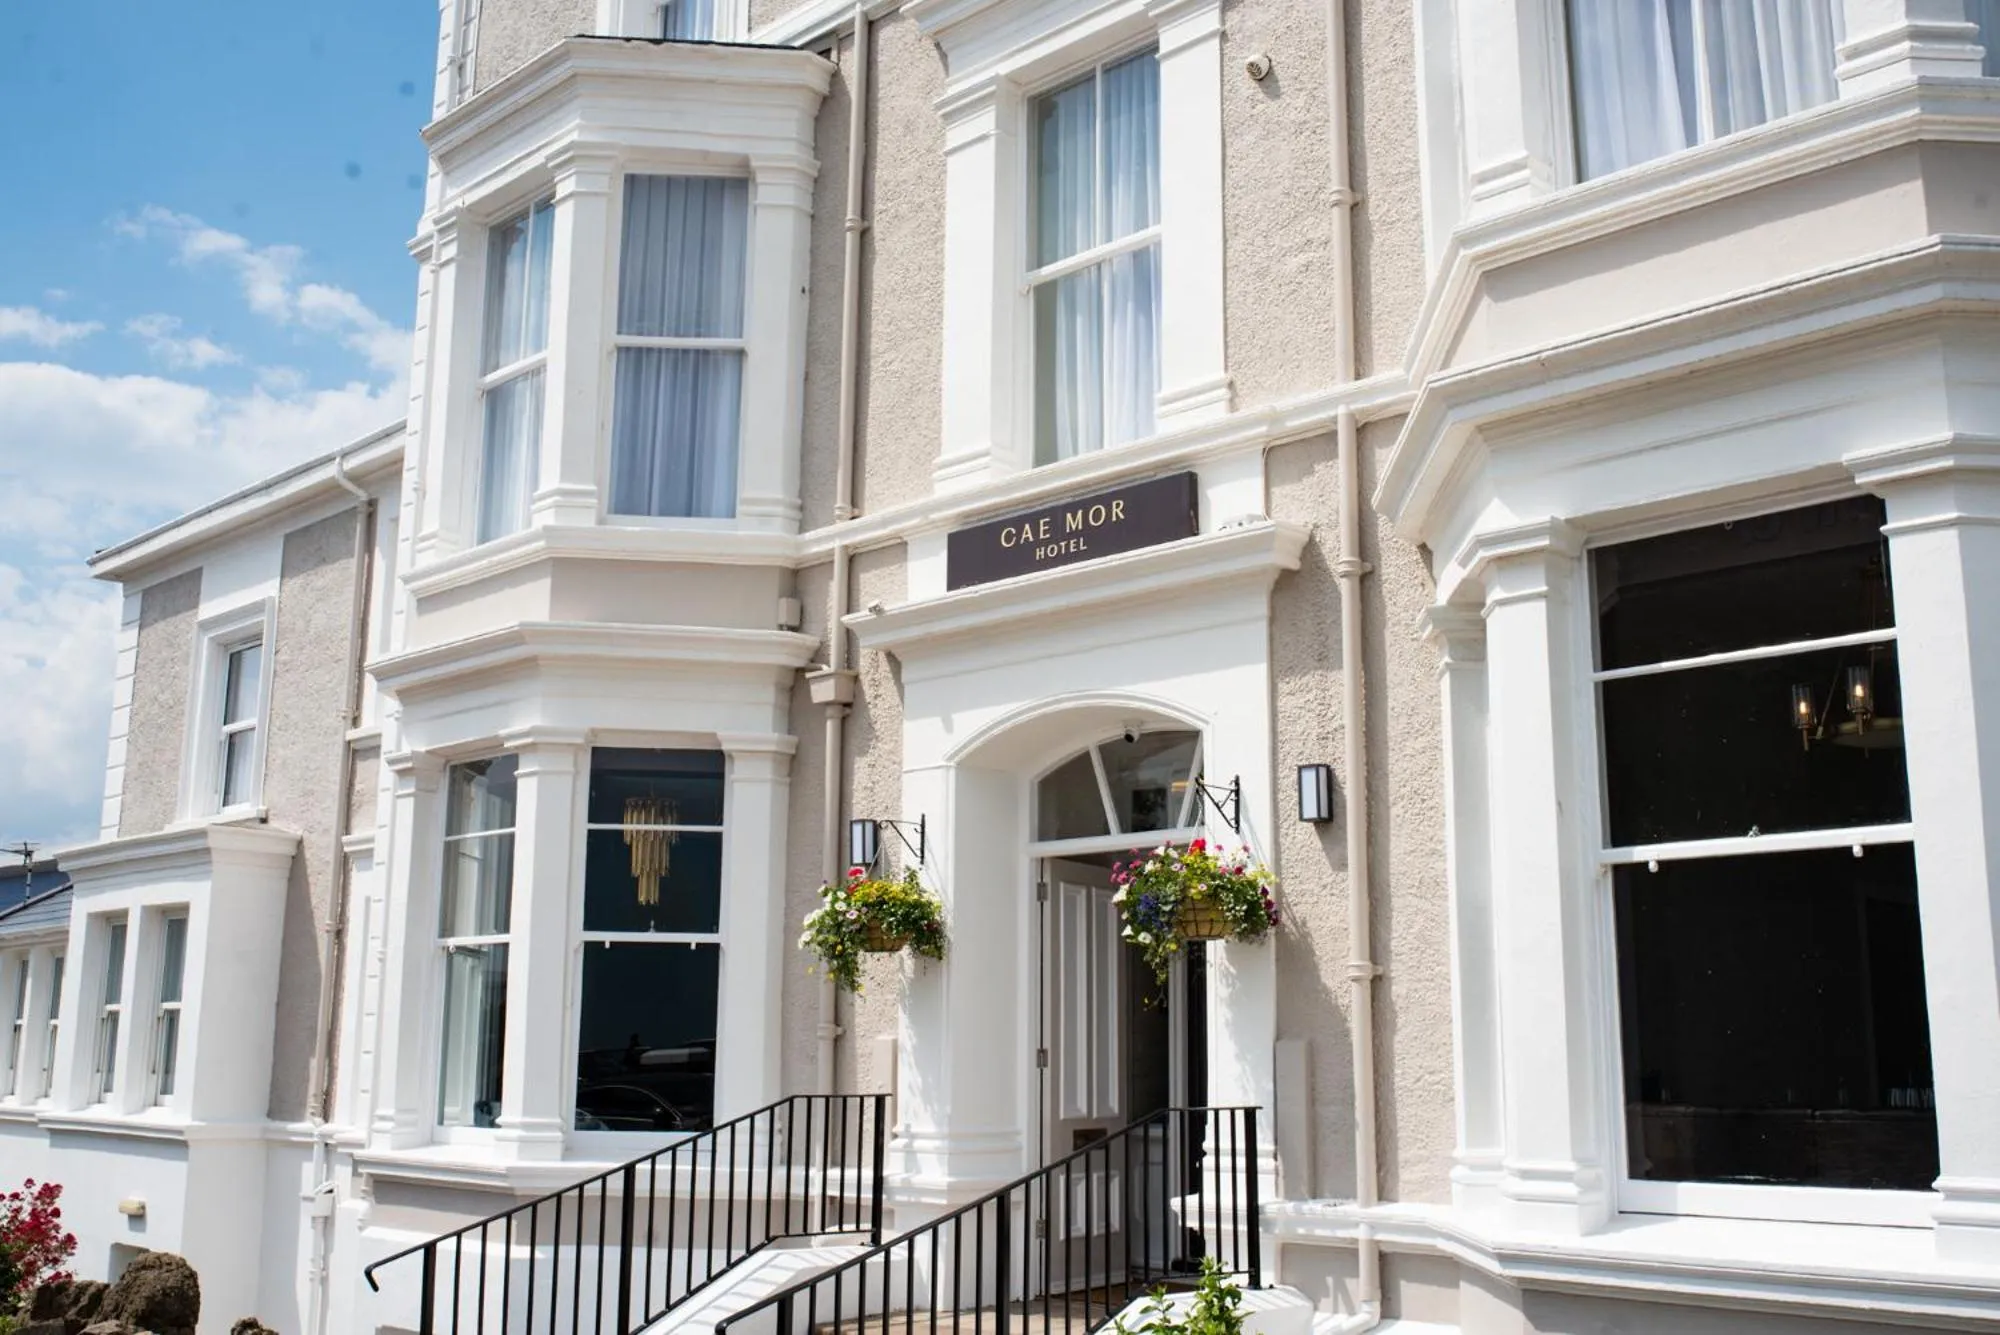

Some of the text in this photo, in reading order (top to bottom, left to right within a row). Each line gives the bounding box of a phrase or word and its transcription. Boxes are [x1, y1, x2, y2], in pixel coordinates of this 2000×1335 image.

[1000, 499, 1126, 548] CAE MOR
[1036, 537, 1087, 560] HOTEL
